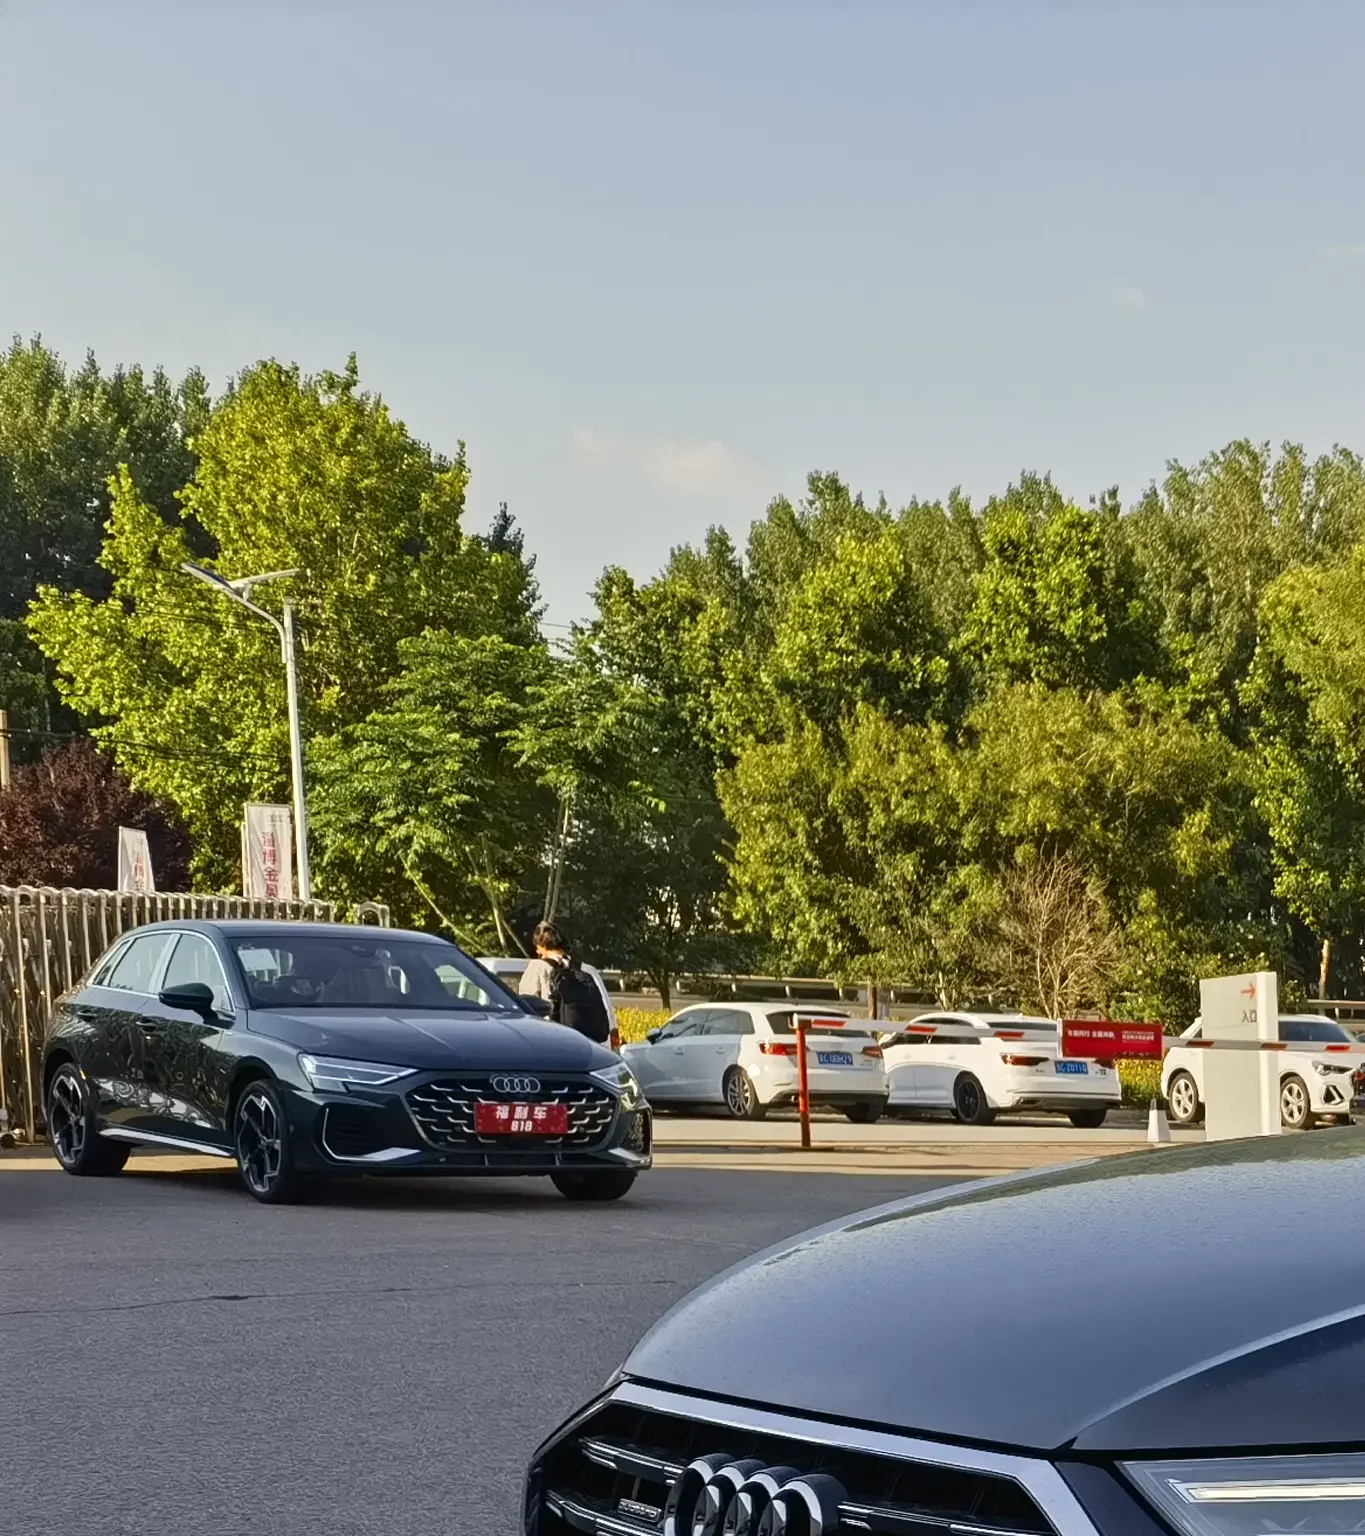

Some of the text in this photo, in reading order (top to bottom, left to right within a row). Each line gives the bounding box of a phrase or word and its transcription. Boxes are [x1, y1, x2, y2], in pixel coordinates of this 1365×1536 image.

[1241, 1008, 1258, 1023] 入口
[496, 1105, 548, 1120] 福利车
